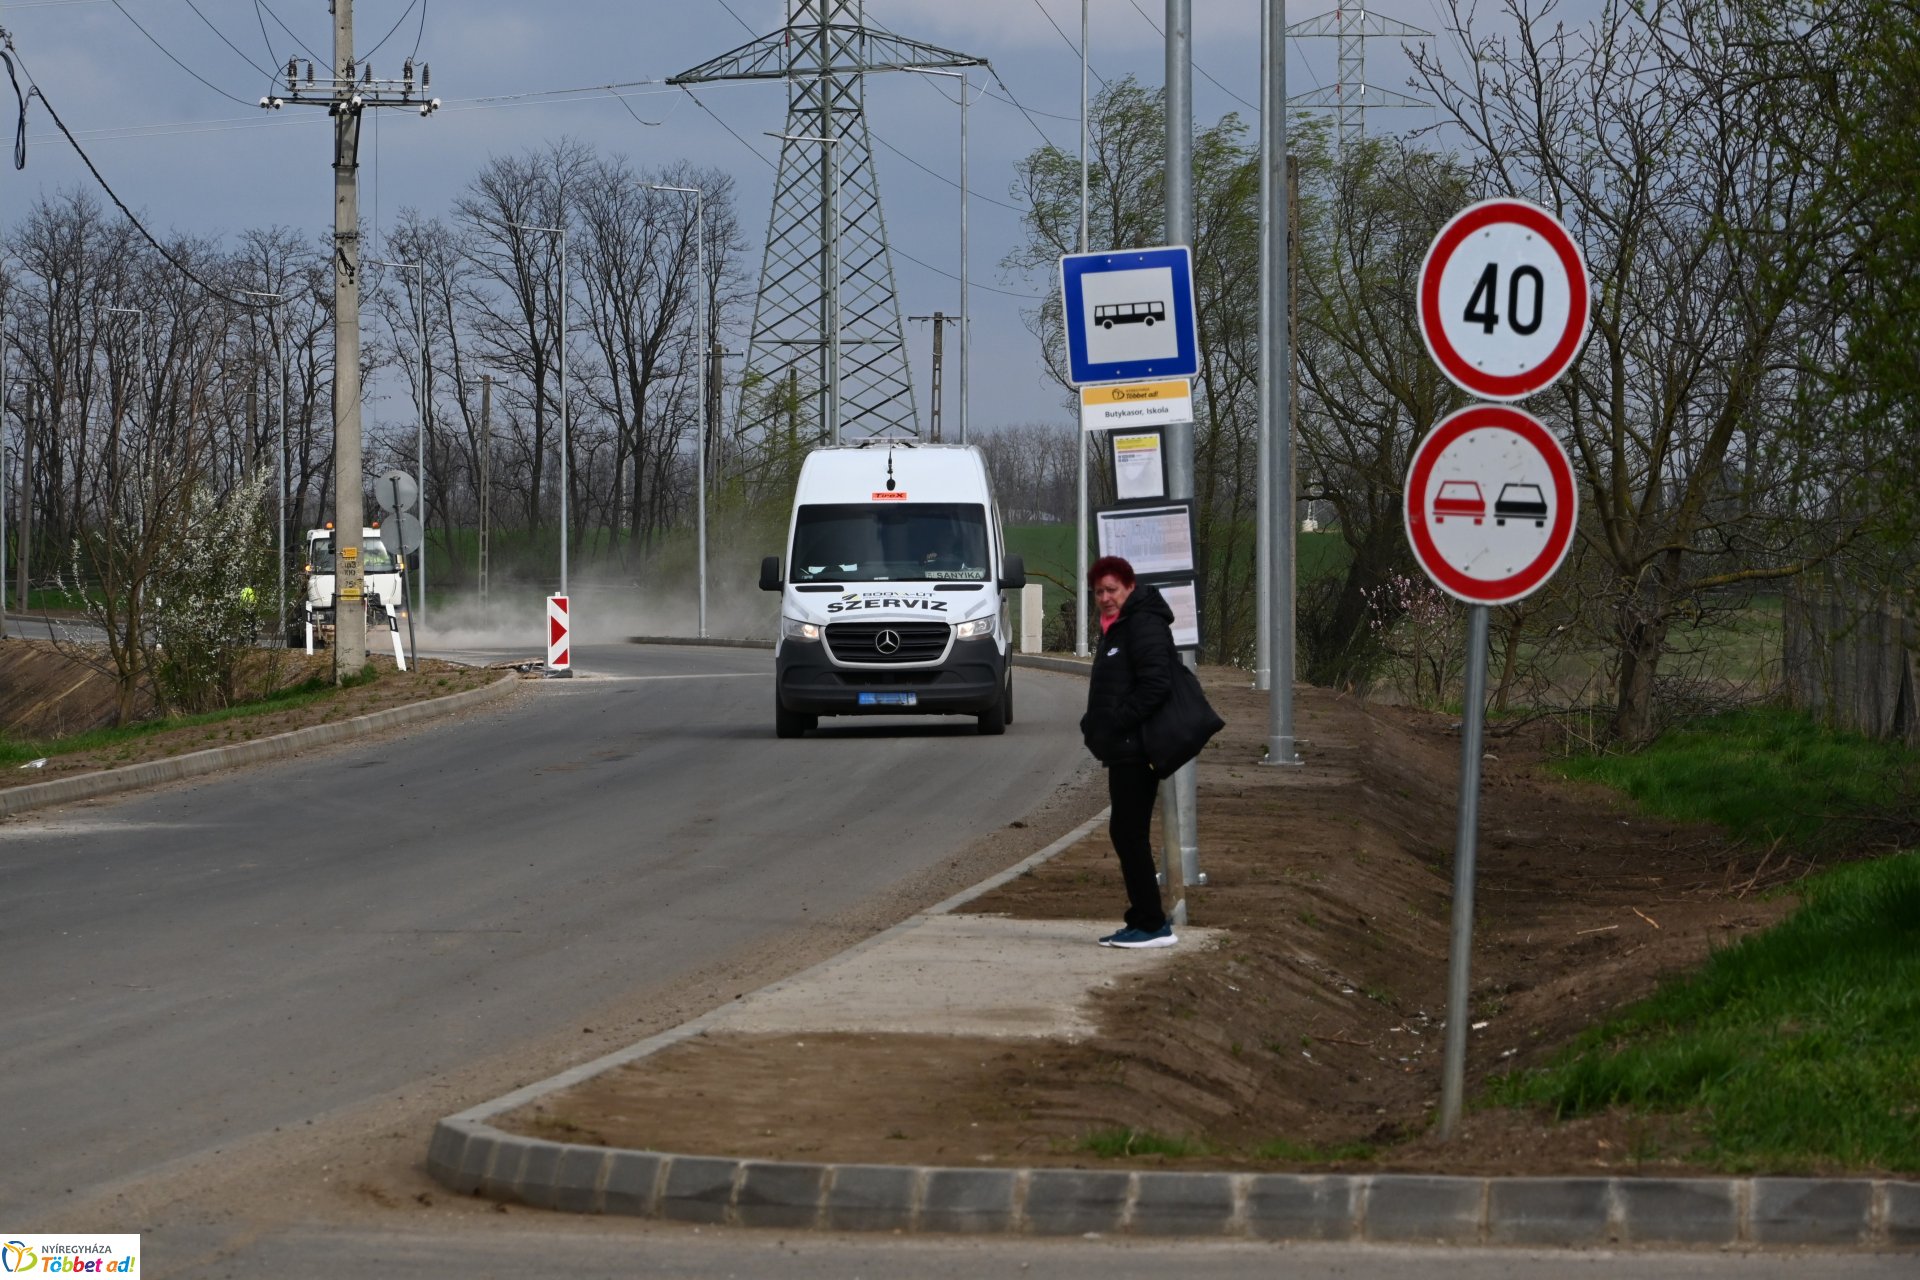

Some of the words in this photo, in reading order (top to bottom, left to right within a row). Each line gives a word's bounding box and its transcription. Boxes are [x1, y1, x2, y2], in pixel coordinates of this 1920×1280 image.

[1463, 262, 1544, 336] 40
[1105, 409, 1144, 418] Butykasor,
[1146, 406, 1169, 415] Iskola
[827, 598, 948, 613] SZERVIZ
